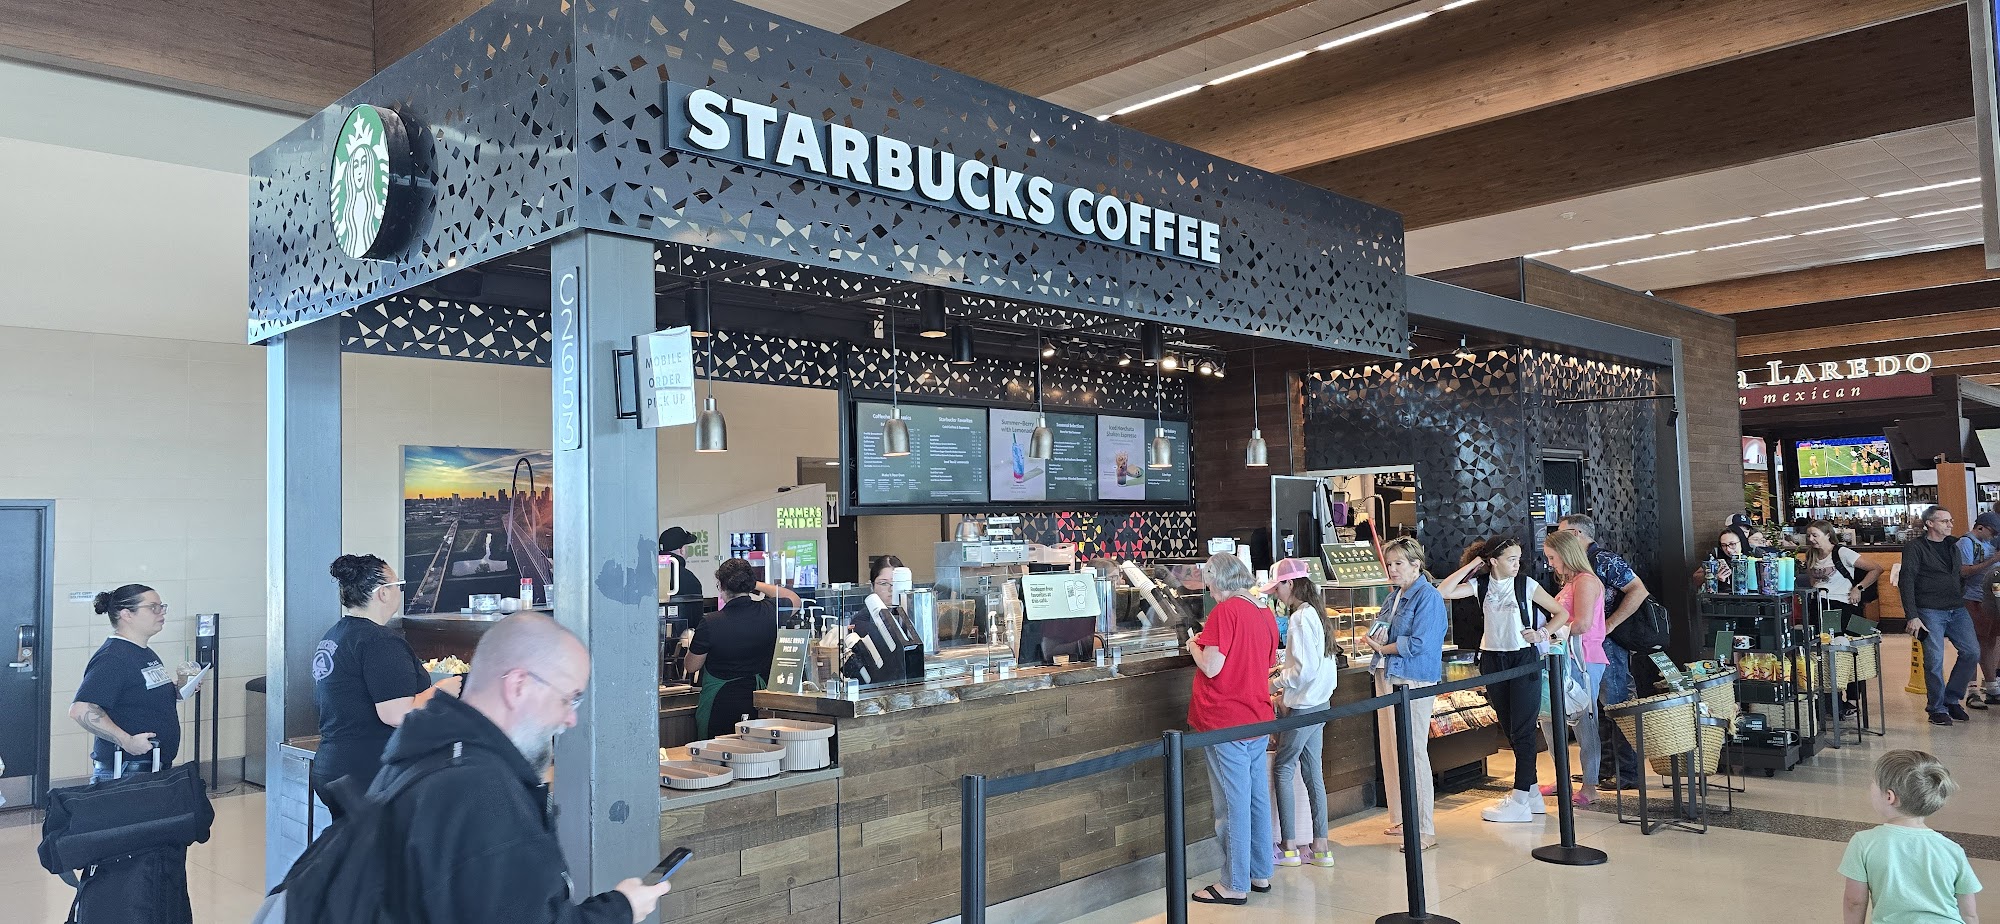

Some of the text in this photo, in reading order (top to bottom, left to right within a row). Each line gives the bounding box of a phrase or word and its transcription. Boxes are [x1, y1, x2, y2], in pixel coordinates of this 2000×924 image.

[687, 88, 1221, 264] STARBUCKS COFFEE
[559, 272, 575, 444] C2653
[645, 351, 682, 369] MOBILE
[1766, 352, 1932, 385] LAREDO
[648, 373, 681, 389] ORDER
[647, 393, 686, 409] PICK UP
[1763, 386, 1861, 404] mexican
[1001, 419, 1035, 427] Summer-Berry
[1012, 426, 1034, 434] Lemonad
[776, 506, 822, 518] FARMER'S
[777, 518, 822, 528] FRIDGE
[782, 645, 792, 653] PICK
